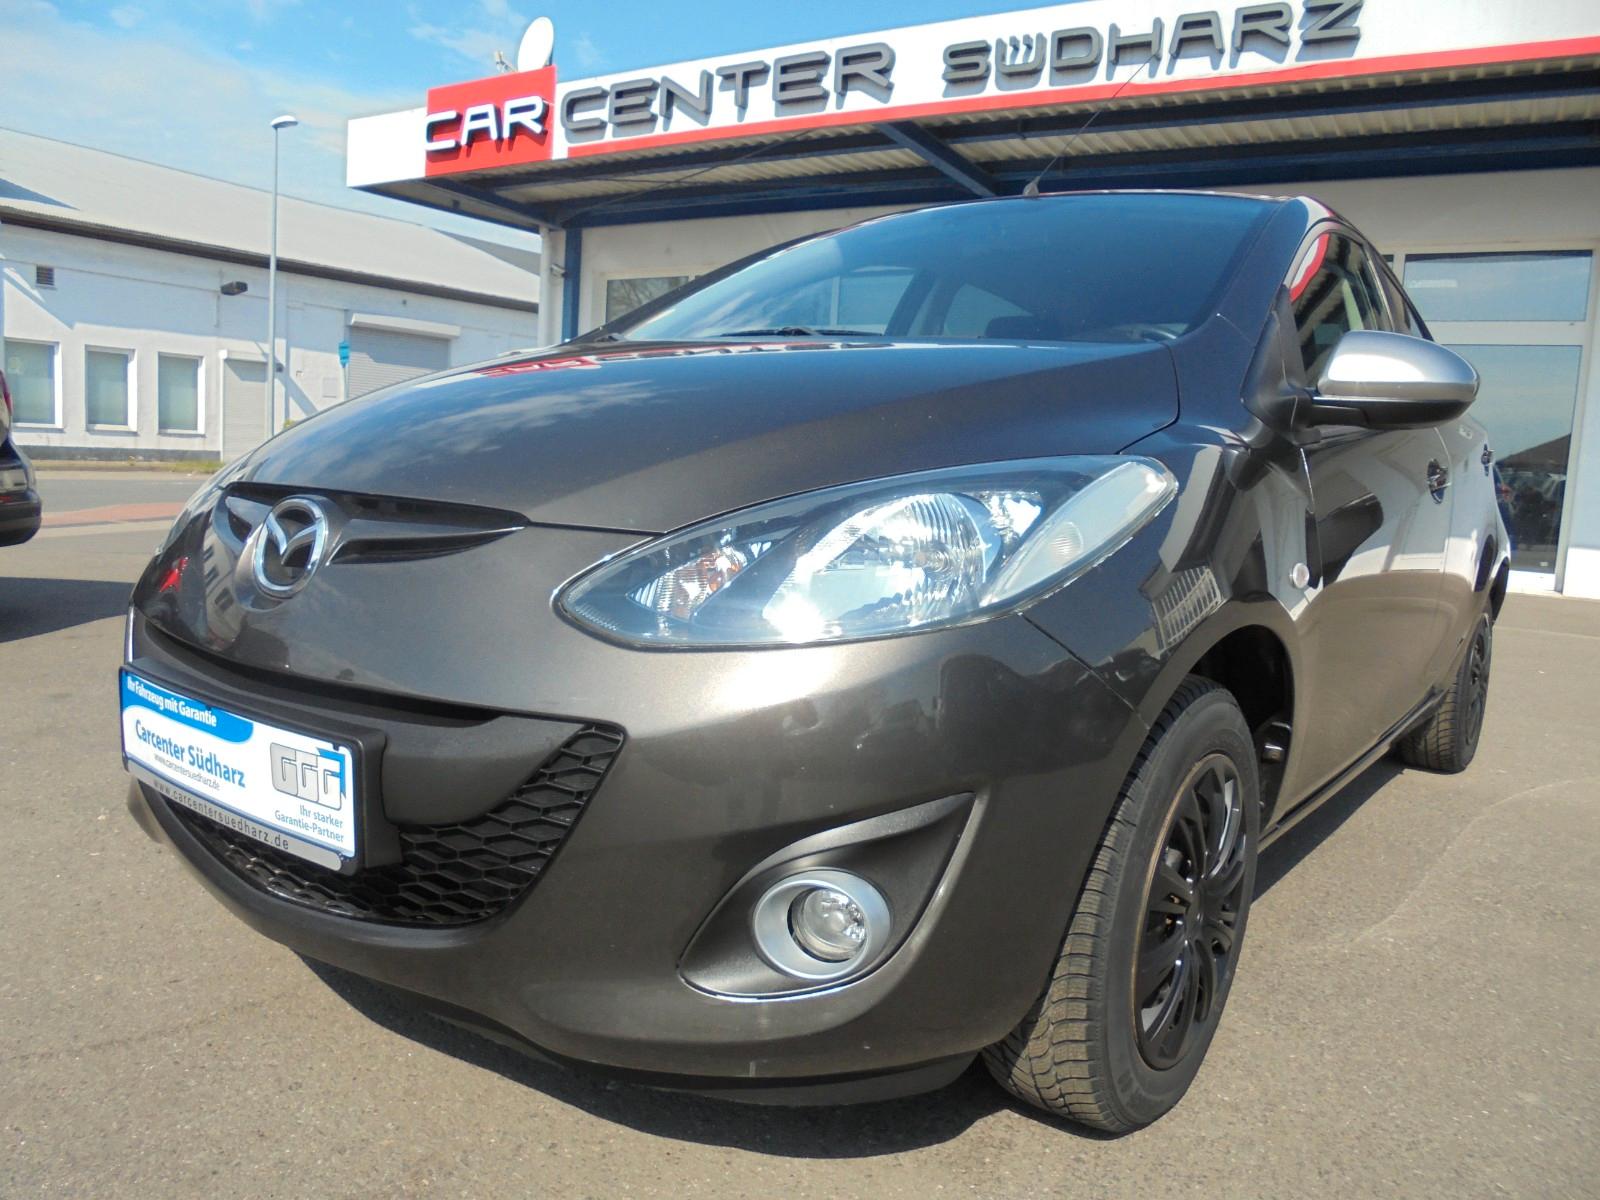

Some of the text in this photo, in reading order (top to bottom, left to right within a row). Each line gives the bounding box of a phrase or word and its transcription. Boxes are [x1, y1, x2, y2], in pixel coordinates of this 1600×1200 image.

[136, 681, 164, 710] Fahrzeug
[164, 696, 178, 713] mit
[179, 701, 217, 727] Garantie
[135, 719, 246, 788] Carcenter Südharz
[274, 809, 344, 842] Garantie-Partner
[299, 804, 344, 828] Ihr starker
